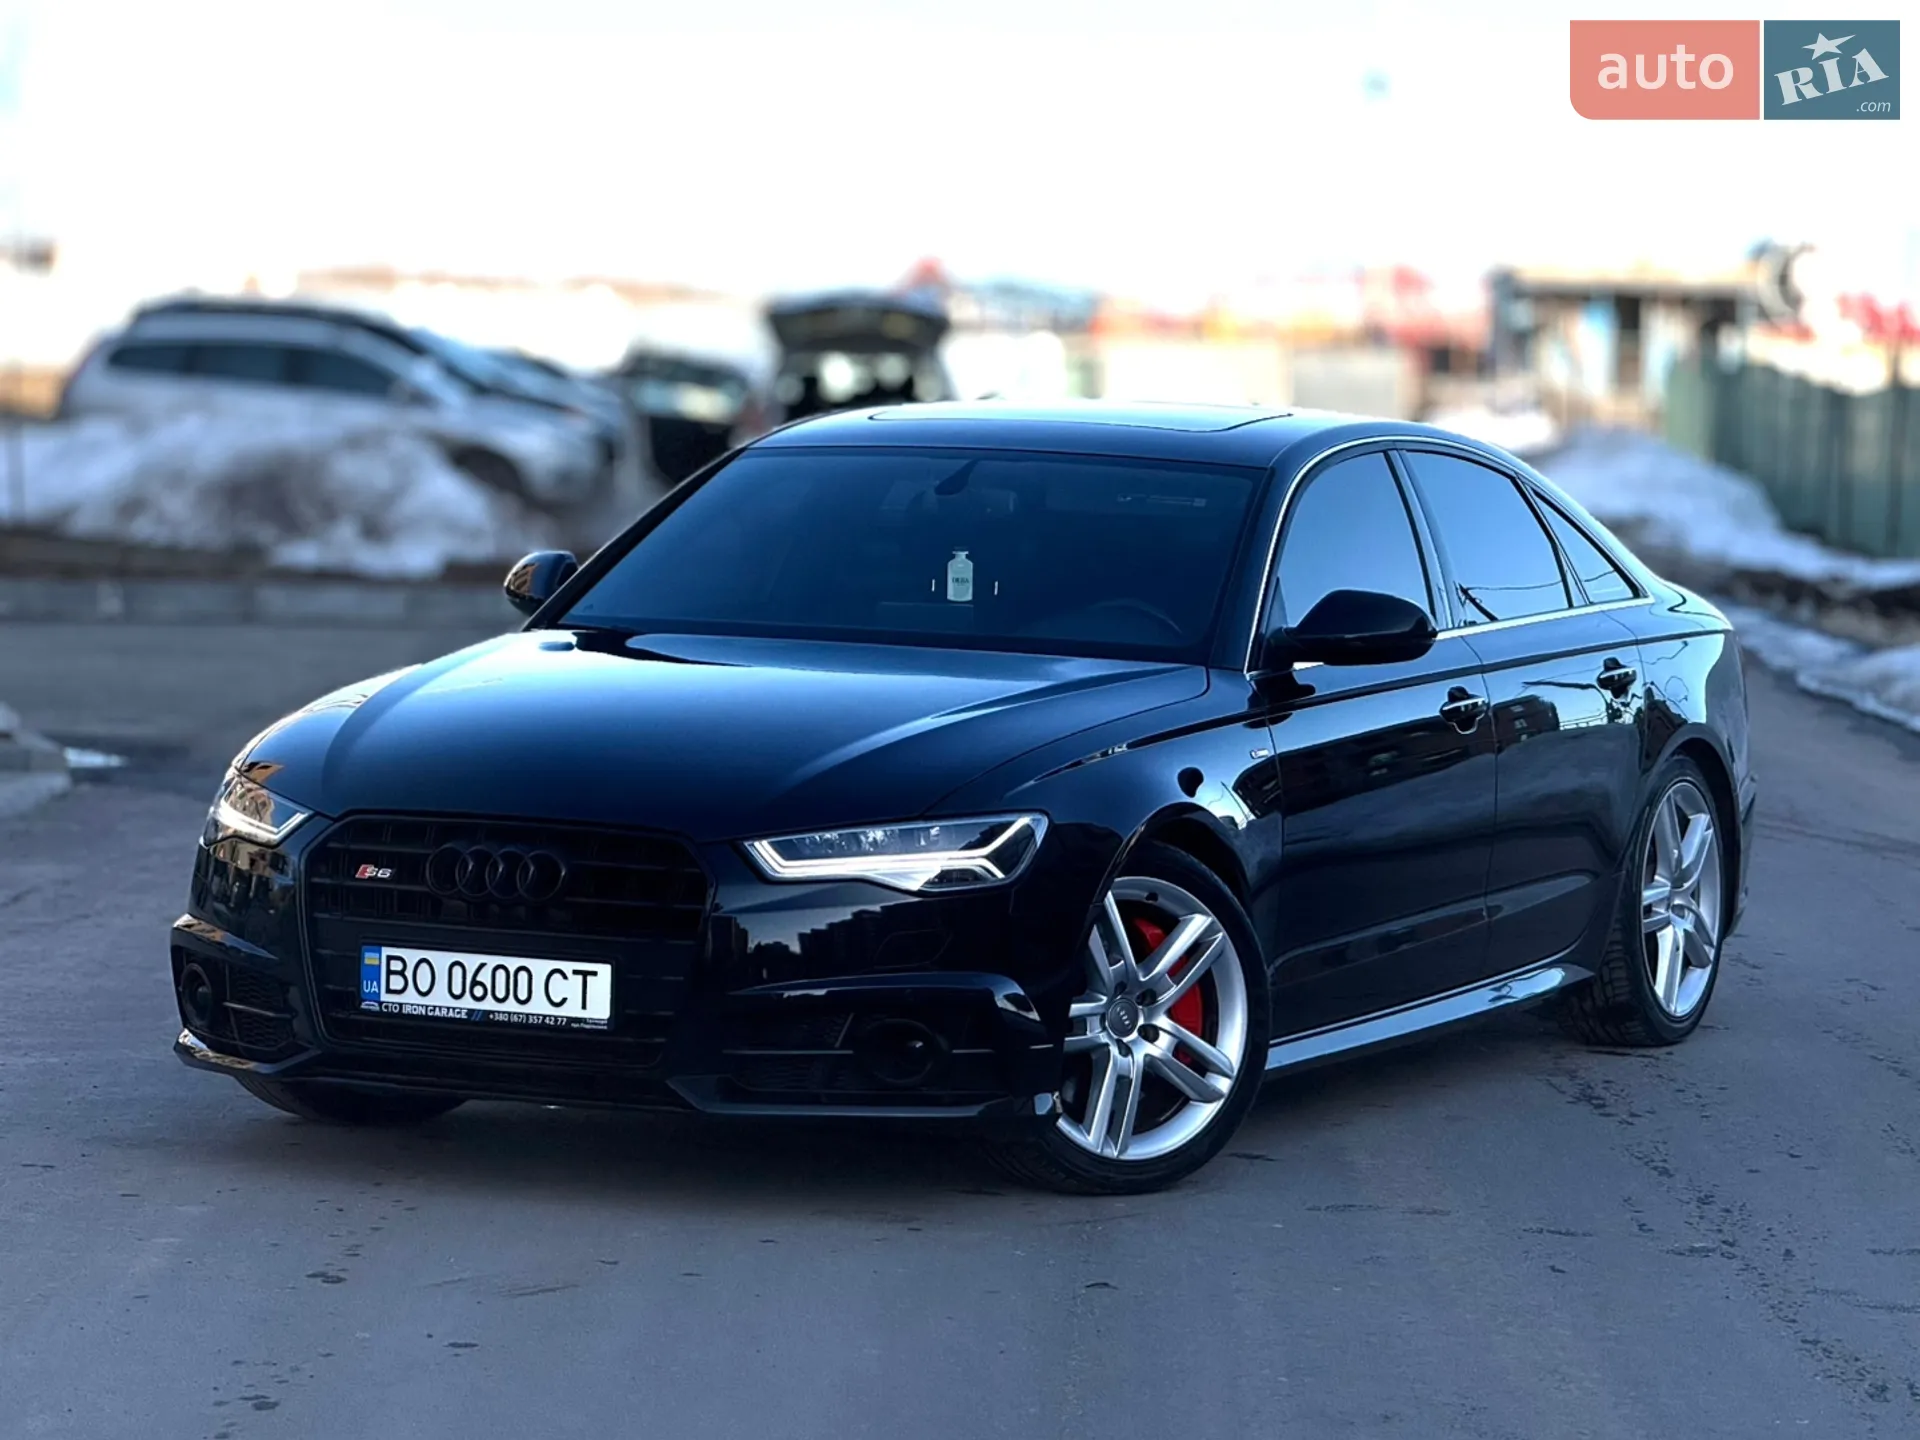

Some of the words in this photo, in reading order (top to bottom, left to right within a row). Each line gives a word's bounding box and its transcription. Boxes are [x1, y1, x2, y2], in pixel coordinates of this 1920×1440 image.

[363, 980, 379, 993] UA
[385, 954, 436, 997] BO
[447, 960, 533, 1005] 0600
[544, 968, 598, 1010] CT
[402, 1004, 426, 1016] IRON
[427, 1006, 468, 1019] GARAGE
[489, 1012, 509, 1022] +380
[510, 1013, 527, 1024] (67)
[528, 1014, 543, 1024] 357
[544, 1016, 555, 1026] 42
[556, 1017, 567, 1026] 77
